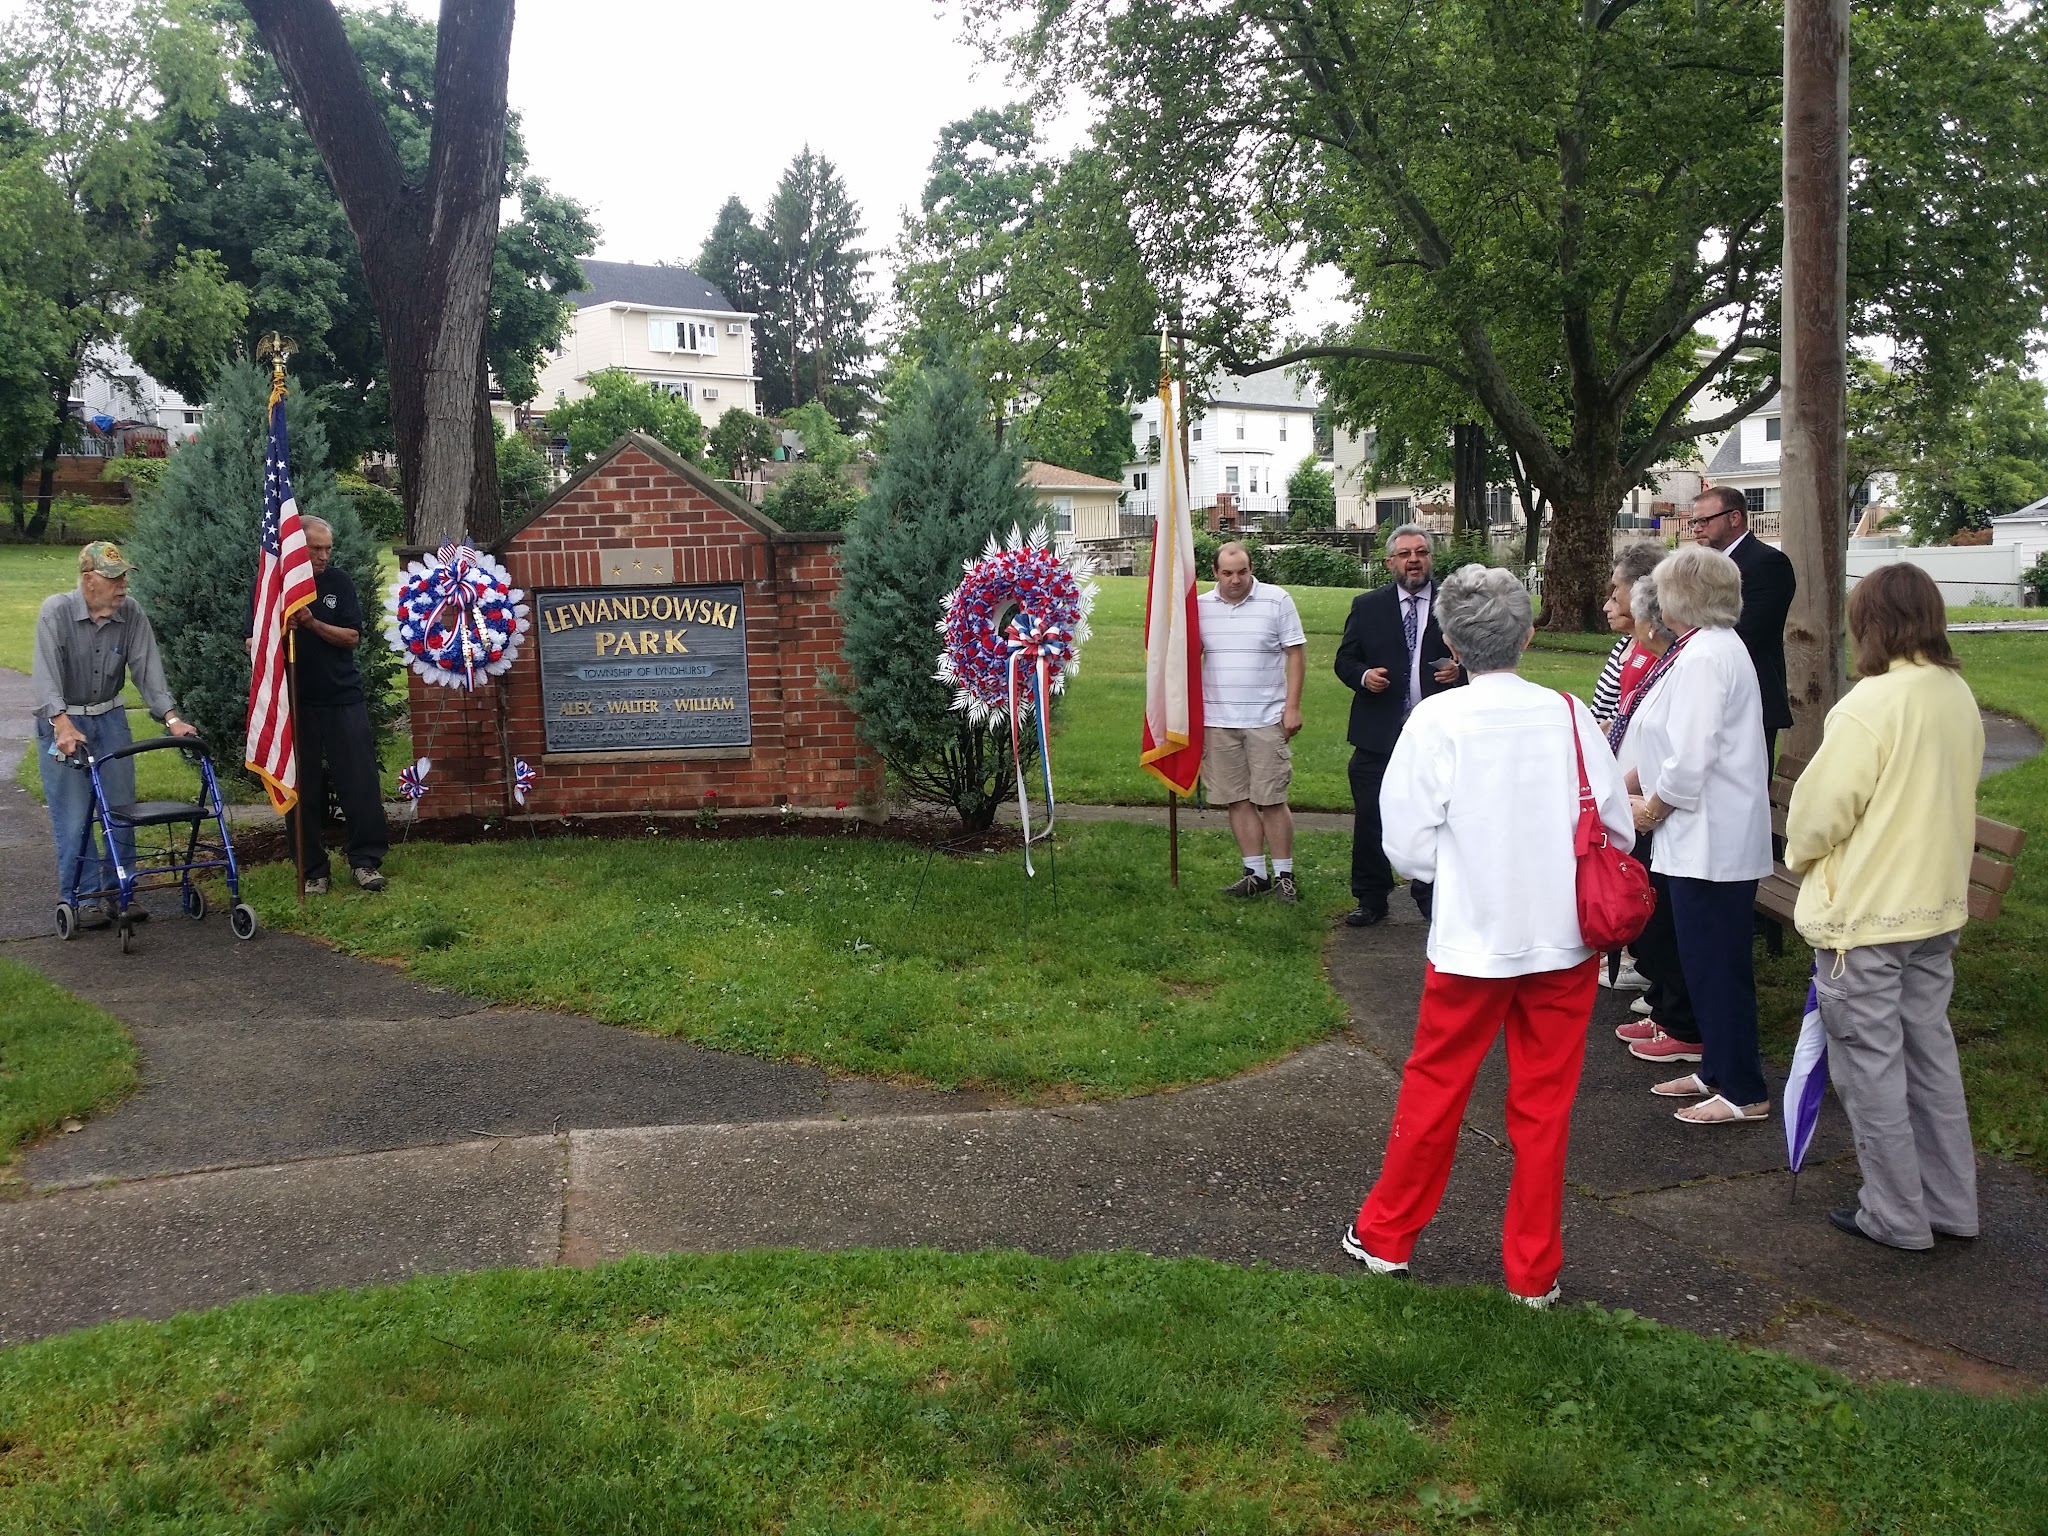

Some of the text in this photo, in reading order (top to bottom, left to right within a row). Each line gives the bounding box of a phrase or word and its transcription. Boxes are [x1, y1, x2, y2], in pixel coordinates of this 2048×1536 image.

[544, 595, 738, 634] LEWANDOWSKI
[595, 629, 689, 656] PARK
[584, 665, 707, 680] TOWNSHIP OF LYNDHURST
[552, 690, 590, 701] DEDICATED
[593, 690, 603, 700] TO
[606, 689, 620, 699] THE
[625, 688, 645, 699] THREE
[706, 685, 741, 696] BROTHERS
[560, 698, 735, 716] ALEX WALTER WILLIAM
[553, 715, 742, 732] WHO SERVED AND GAVE THE ULTIMATE SACRIFICE
[555, 734, 570, 743] FOR
[601, 732, 640, 742] COUNTRY
[644, 730, 677, 741] DURING
